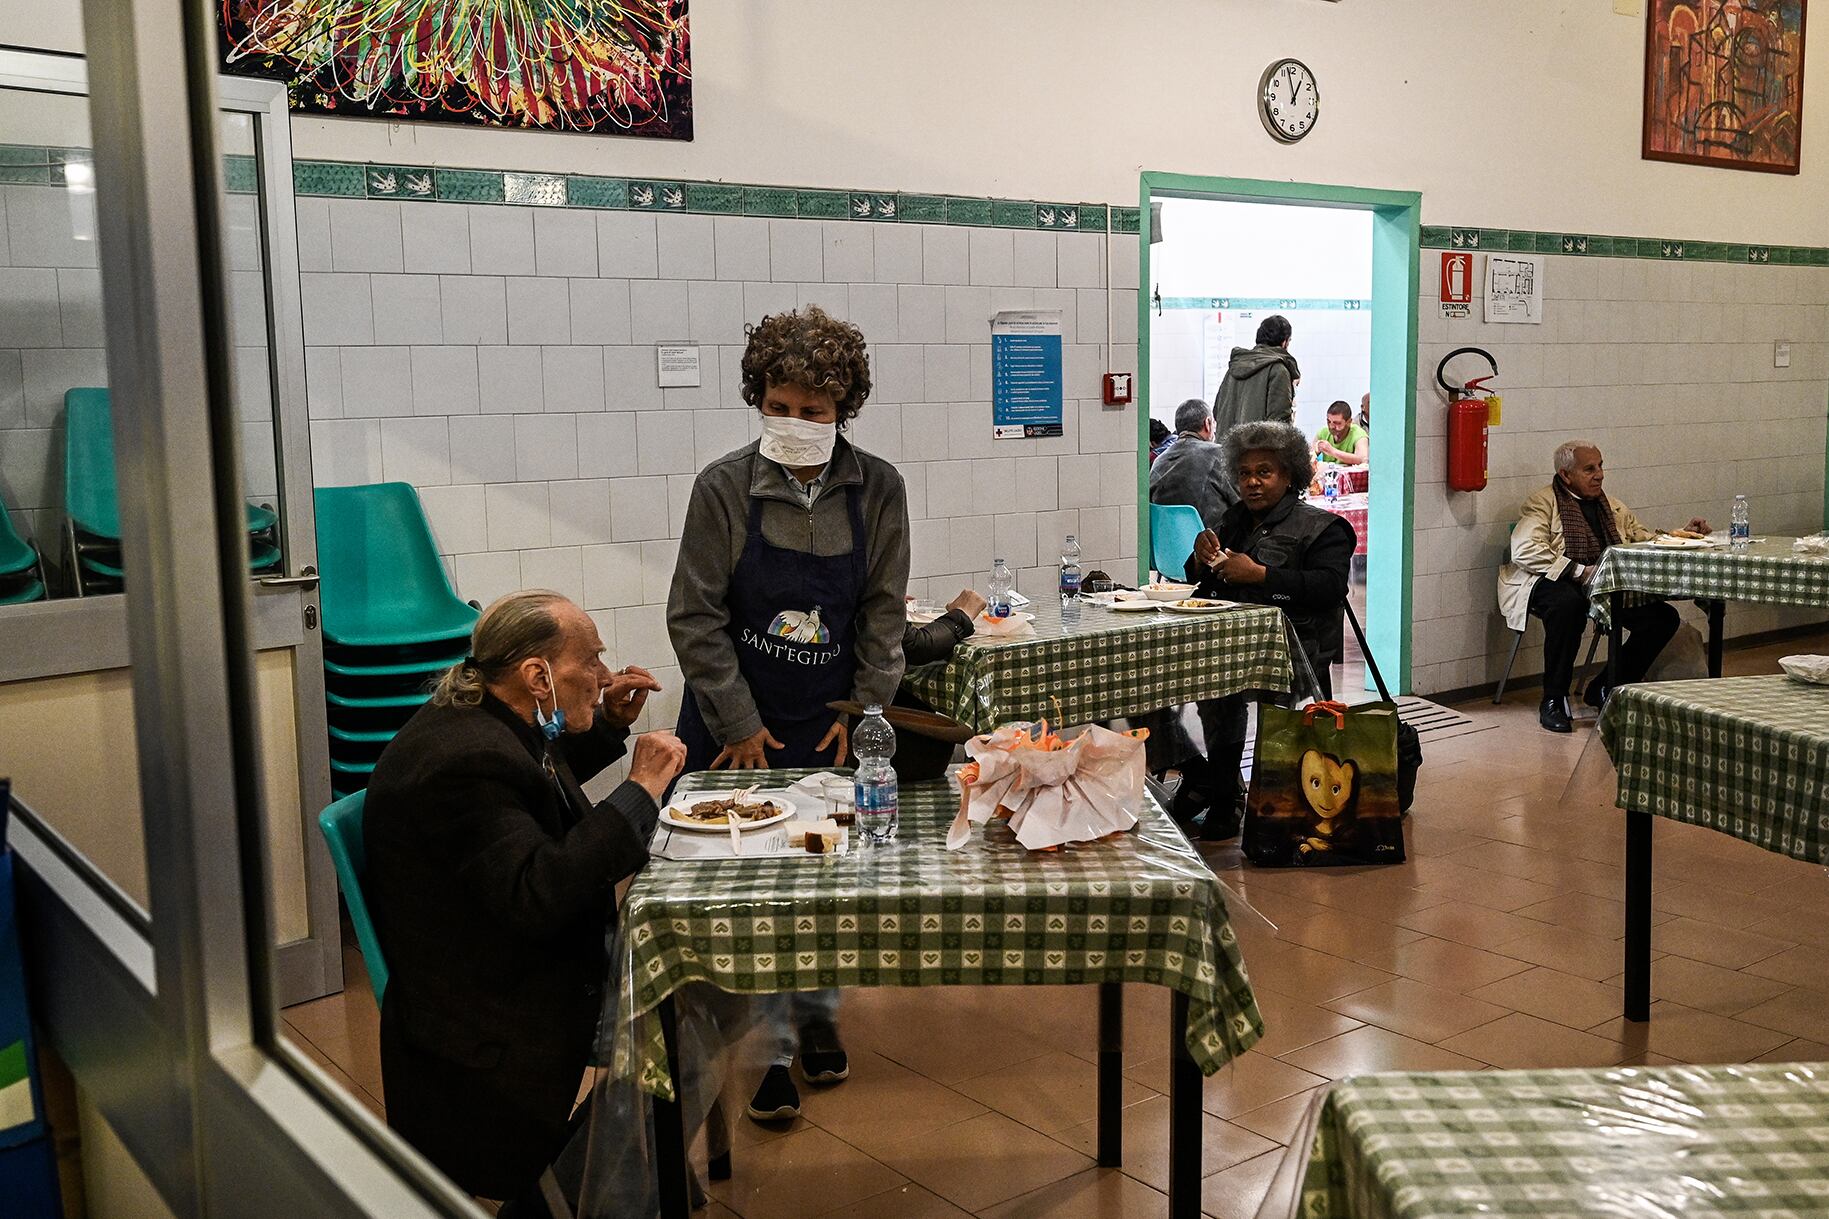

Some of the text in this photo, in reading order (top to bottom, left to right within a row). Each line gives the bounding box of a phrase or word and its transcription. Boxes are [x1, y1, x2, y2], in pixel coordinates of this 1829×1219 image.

[1270, 93, 1276, 101] 9
[1273, 108, 1279, 116] 8
[740, 628, 841, 665] SANT'EGIDO
